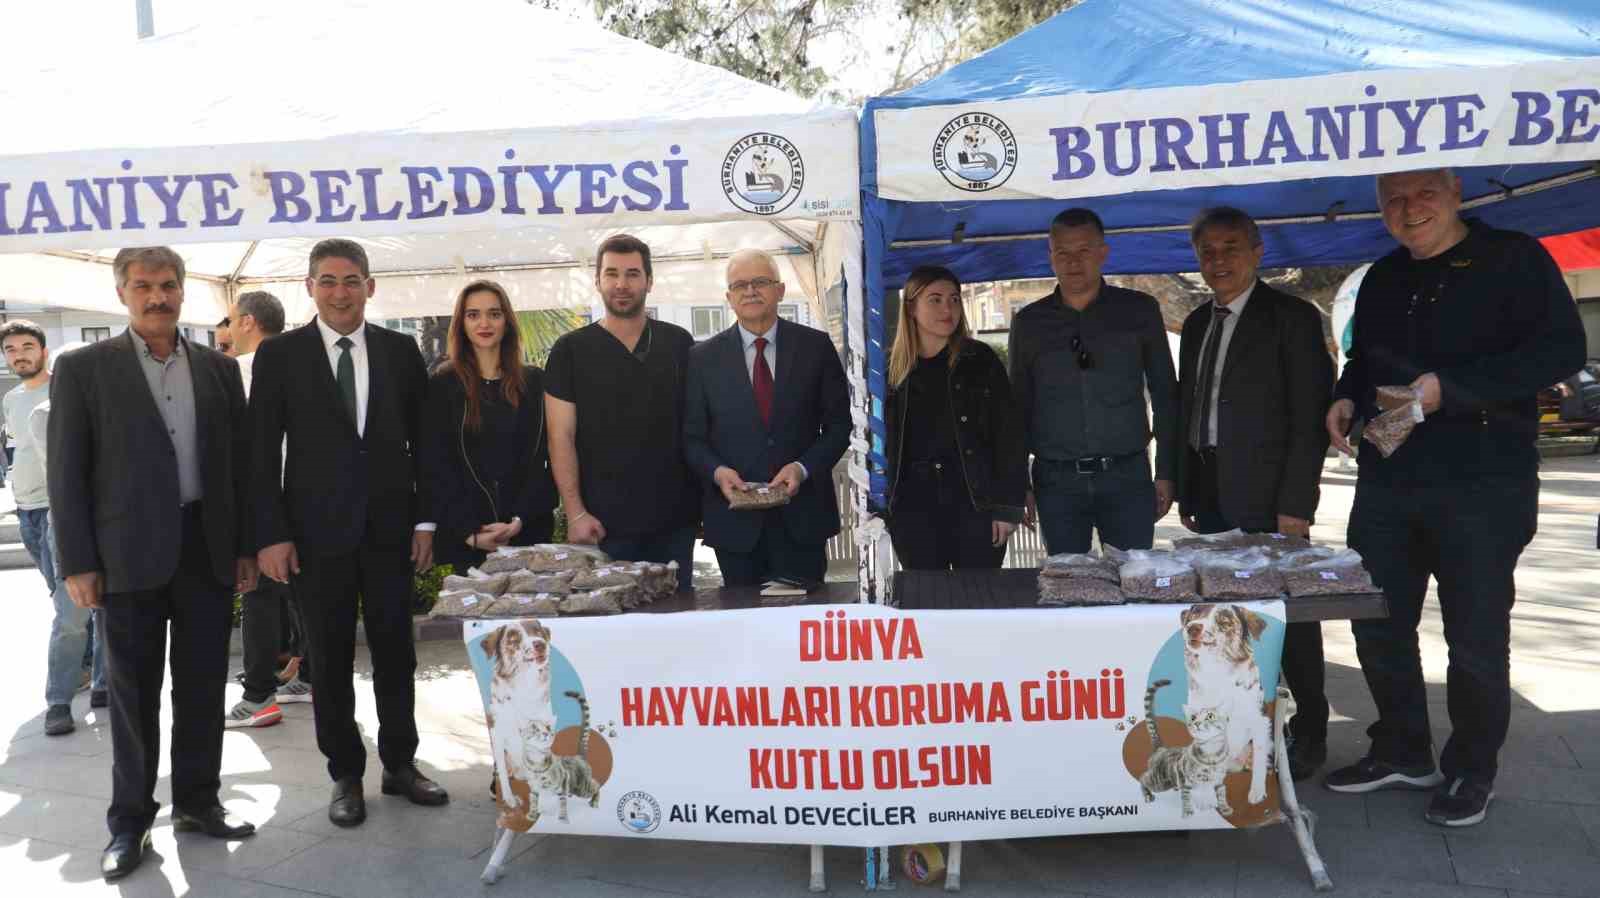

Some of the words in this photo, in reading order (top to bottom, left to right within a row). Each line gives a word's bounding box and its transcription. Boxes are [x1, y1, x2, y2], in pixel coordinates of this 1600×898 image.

[1049, 84, 1490, 181] BURHANİYE
[264, 144, 689, 223] BELEDİYESİ
[723, 136, 759, 194] BURHANİYE
[800, 611, 923, 662] DÜNYA
[621, 686, 840, 727] HAYVANLARI
[850, 682, 1012, 727] KORUMA
[1021, 668, 1125, 722] GÜNÜ
[749, 748, 864, 789] KUTLU
[873, 745, 992, 789] OLSUN
[669, 804, 697, 823] Ali
[705, 806, 778, 825] Kemal
[784, 803, 916, 827] DEVECİLER
[928, 808, 1006, 823] BURHANİYE
[1010, 805, 1075, 820] BELEDİYE
[1079, 804, 1139, 820] BAŞKANI
